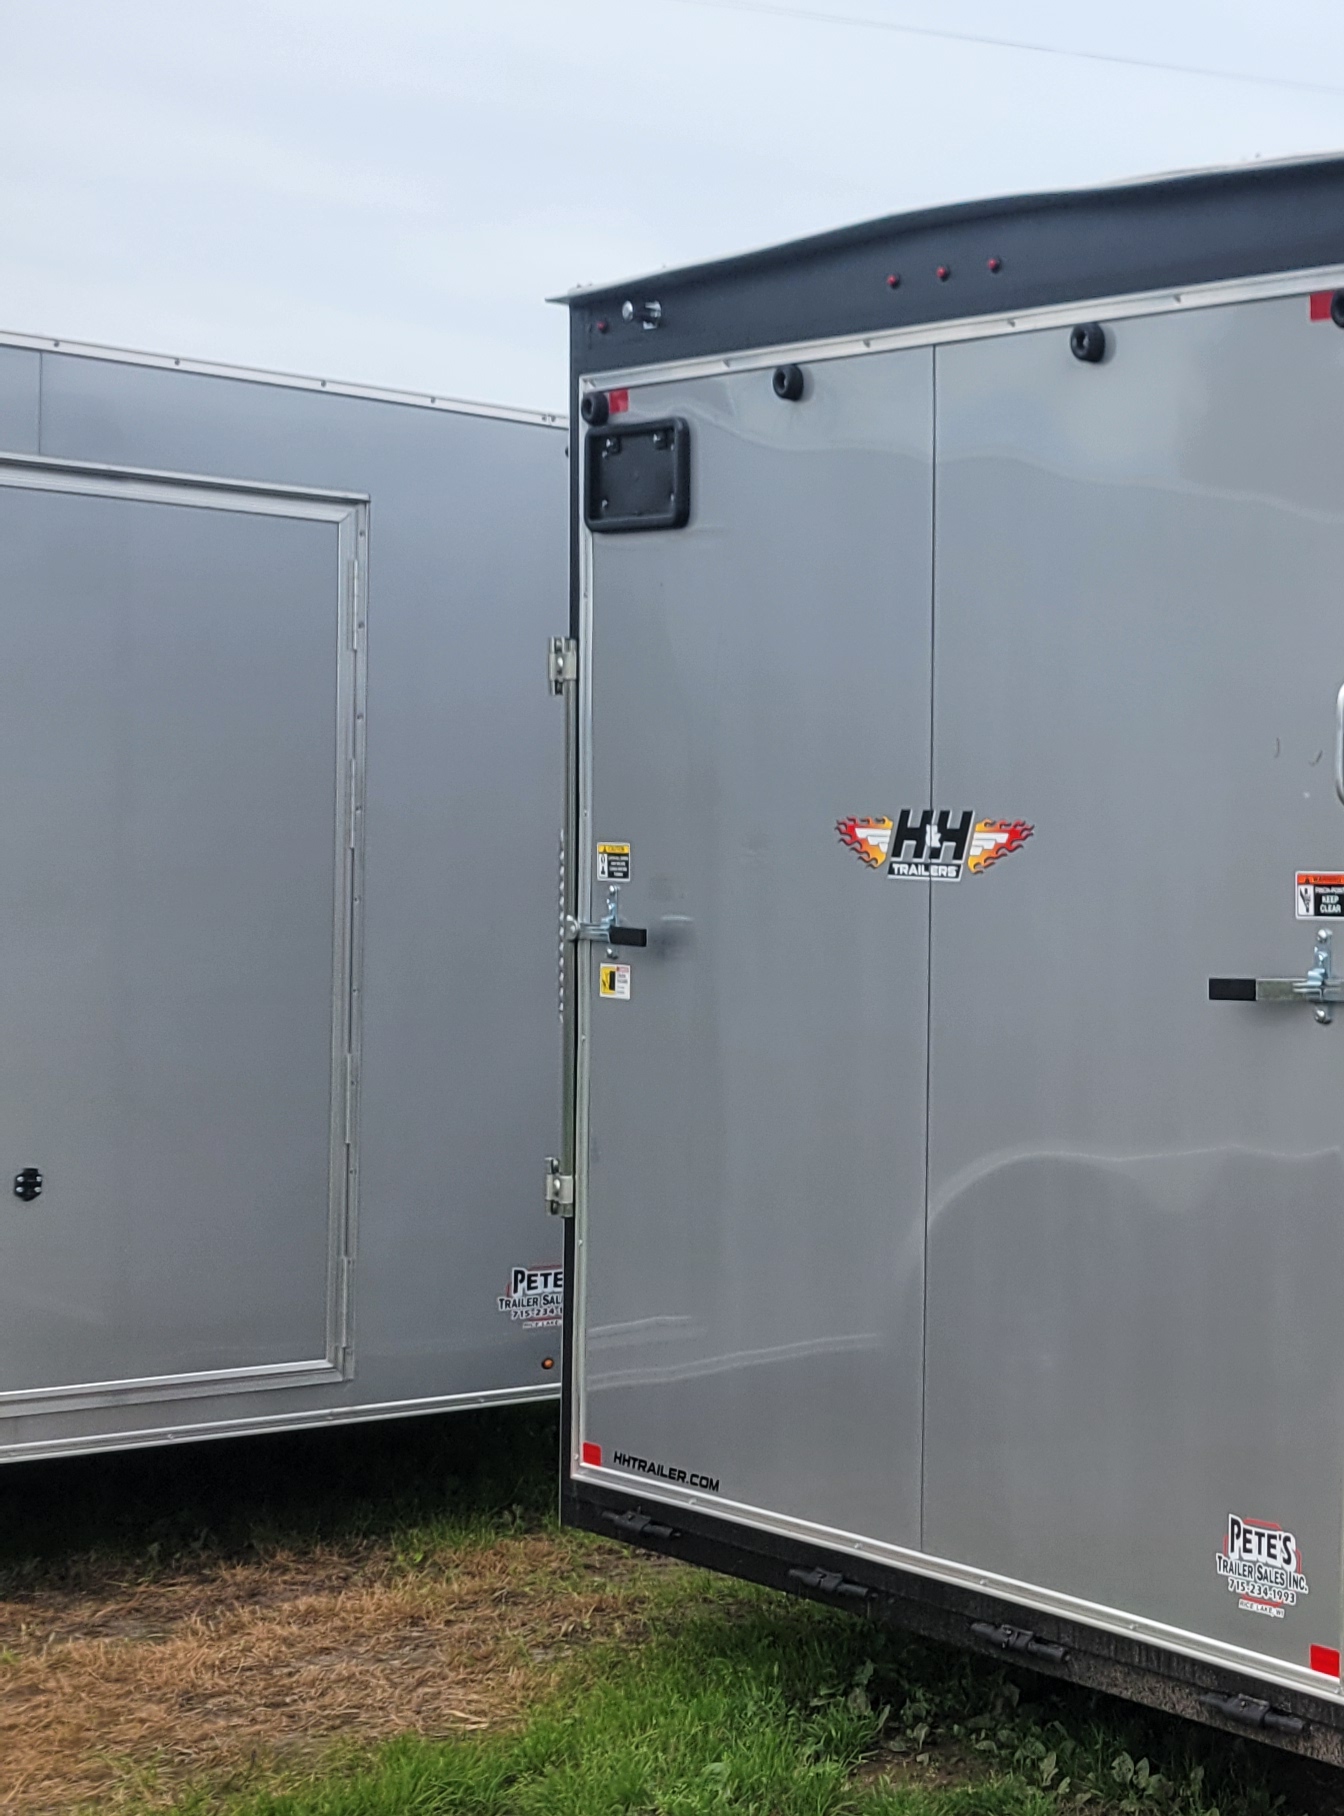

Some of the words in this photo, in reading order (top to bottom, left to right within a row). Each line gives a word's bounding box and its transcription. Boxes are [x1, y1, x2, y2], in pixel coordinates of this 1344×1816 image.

[891, 863, 959, 878] TRAILERS
[1320, 904, 1342, 914] CLEAR
[1321, 895, 1340, 904] KEEP
[498, 1297, 539, 1310] TRAILER
[612, 1450, 720, 1492] HHTRAILER.COM
[1229, 1516, 1293, 1566] PETE'S
[1216, 1555, 1254, 1579] TRAILER
[1256, 1564, 1286, 1587] SALES
[1288, 1571, 1308, 1592] INC.
[1228, 1578, 1296, 1604] 715-234-1993
